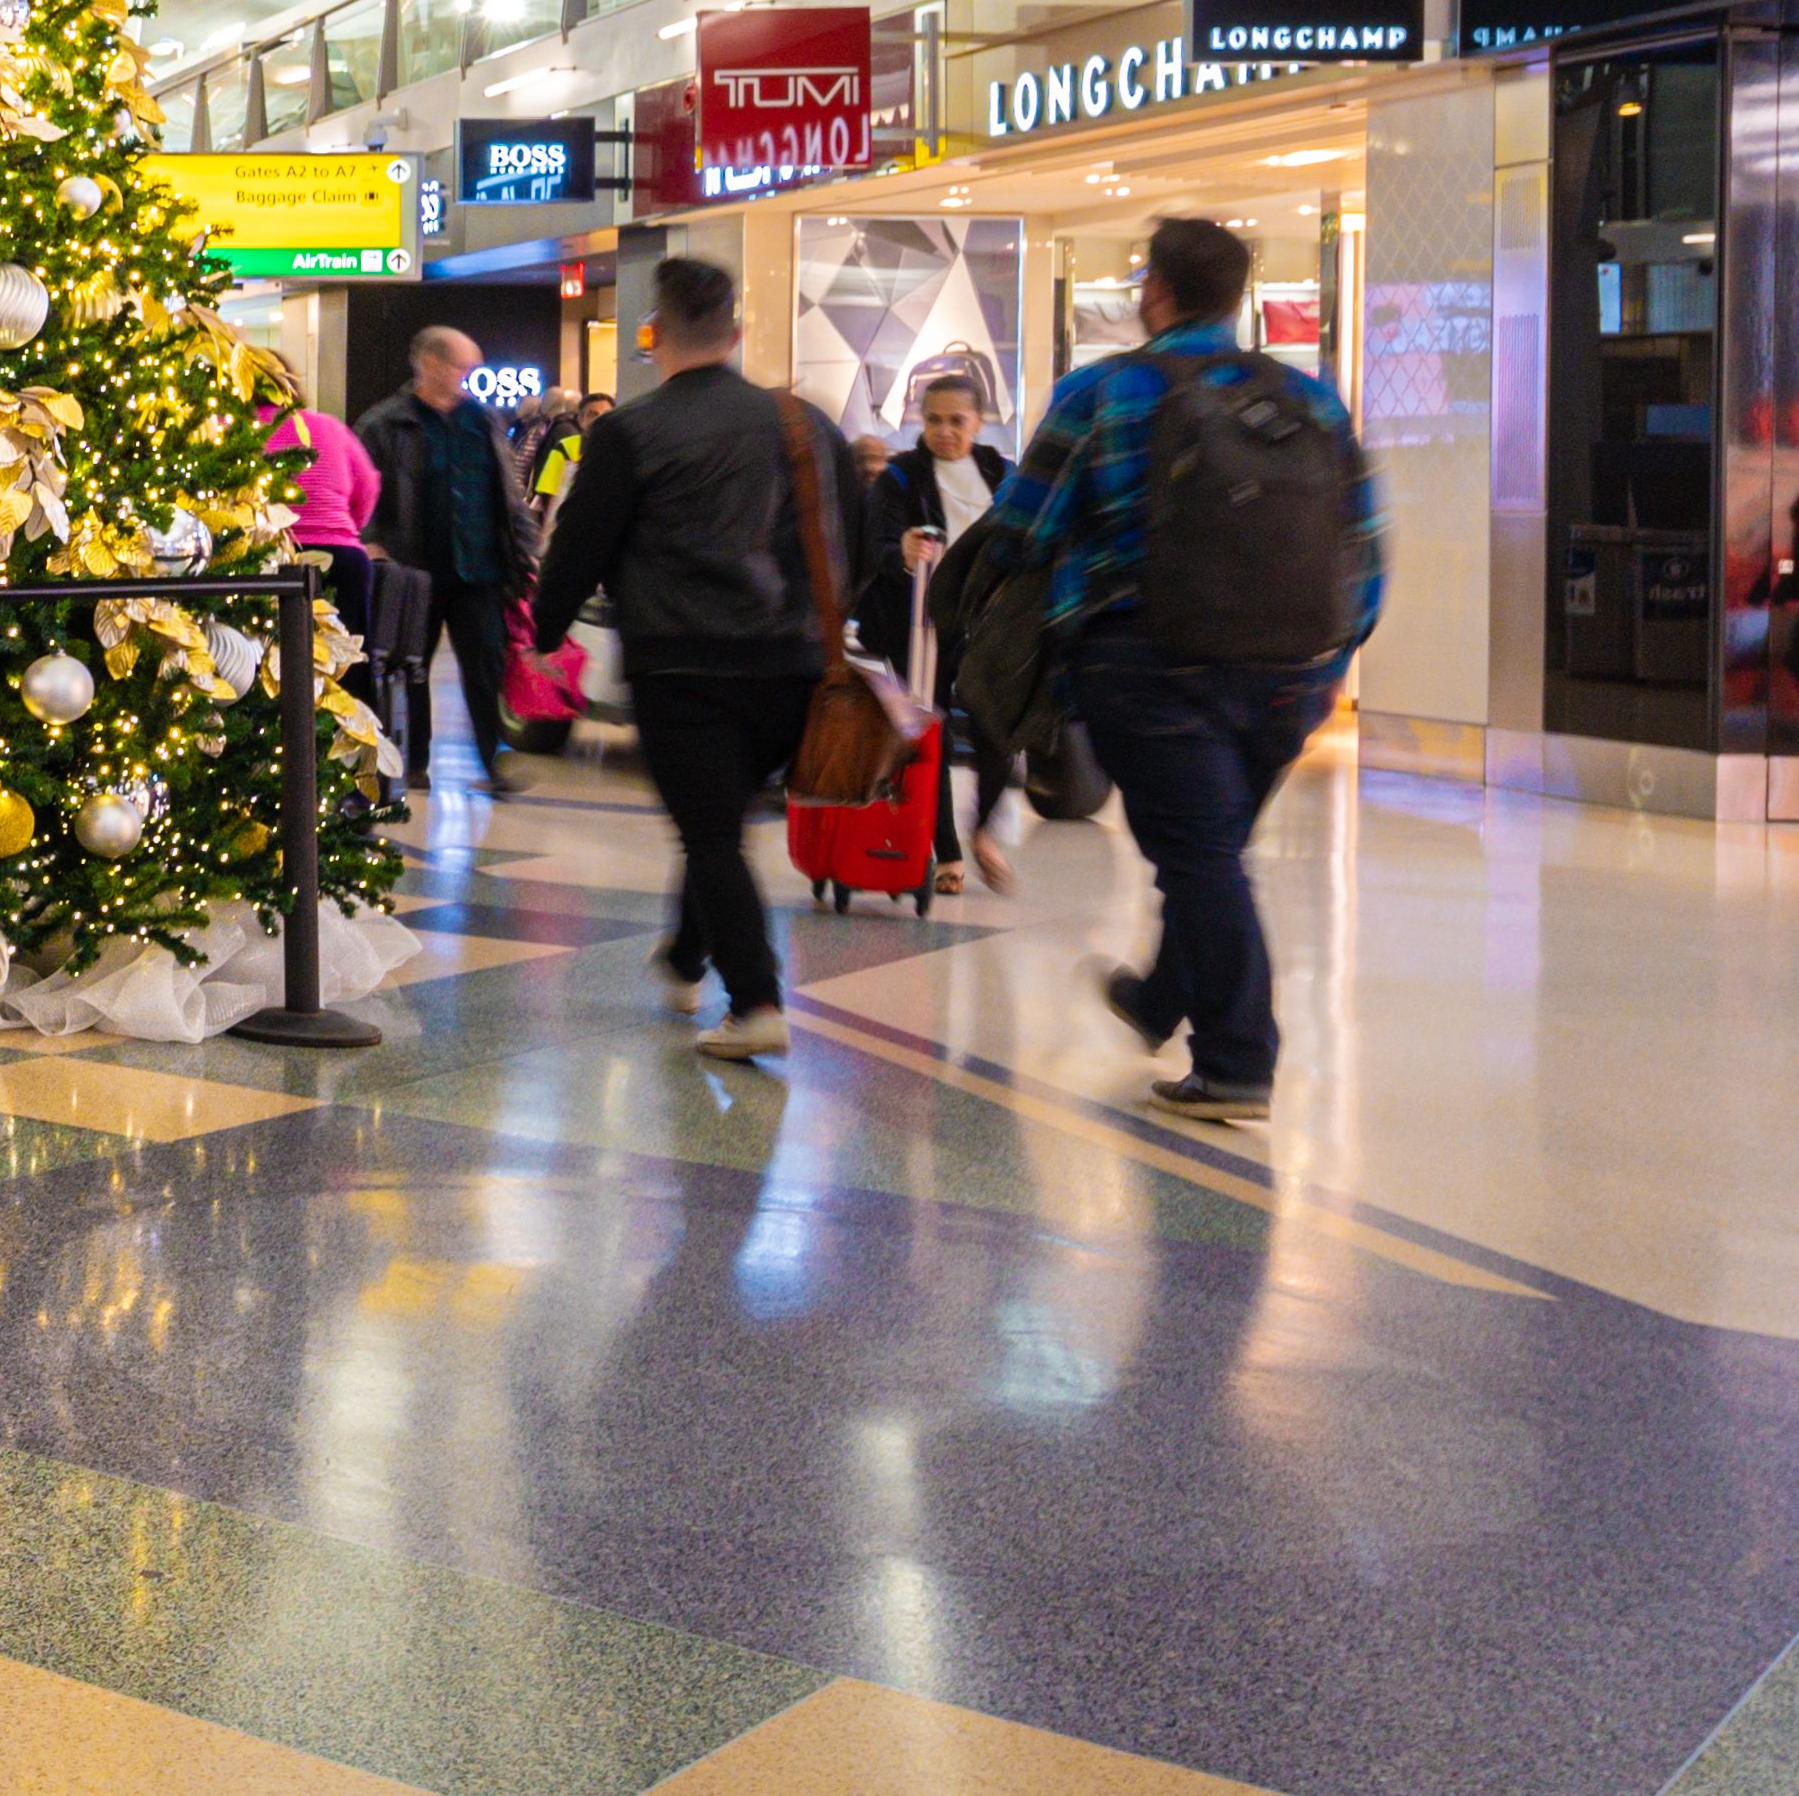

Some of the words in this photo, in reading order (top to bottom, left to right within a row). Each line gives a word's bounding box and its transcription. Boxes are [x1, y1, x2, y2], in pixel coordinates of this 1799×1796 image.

[1209, 26, 1407, 50] LONGCHAMP
[713, 66, 859, 108] TUMI
[989, 36, 1304, 137] LONGCH
[490, 144, 566, 167] BOSS
[235, 165, 280, 179] Gates
[287, 165, 307, 179] A2
[314, 165, 329, 179] to
[335, 165, 356, 179] A7
[237, 191, 306, 207] Baggage
[312, 190, 357, 204] Claim
[292, 253, 357, 269] AirTrain
[462, 367, 541, 397] OSS
